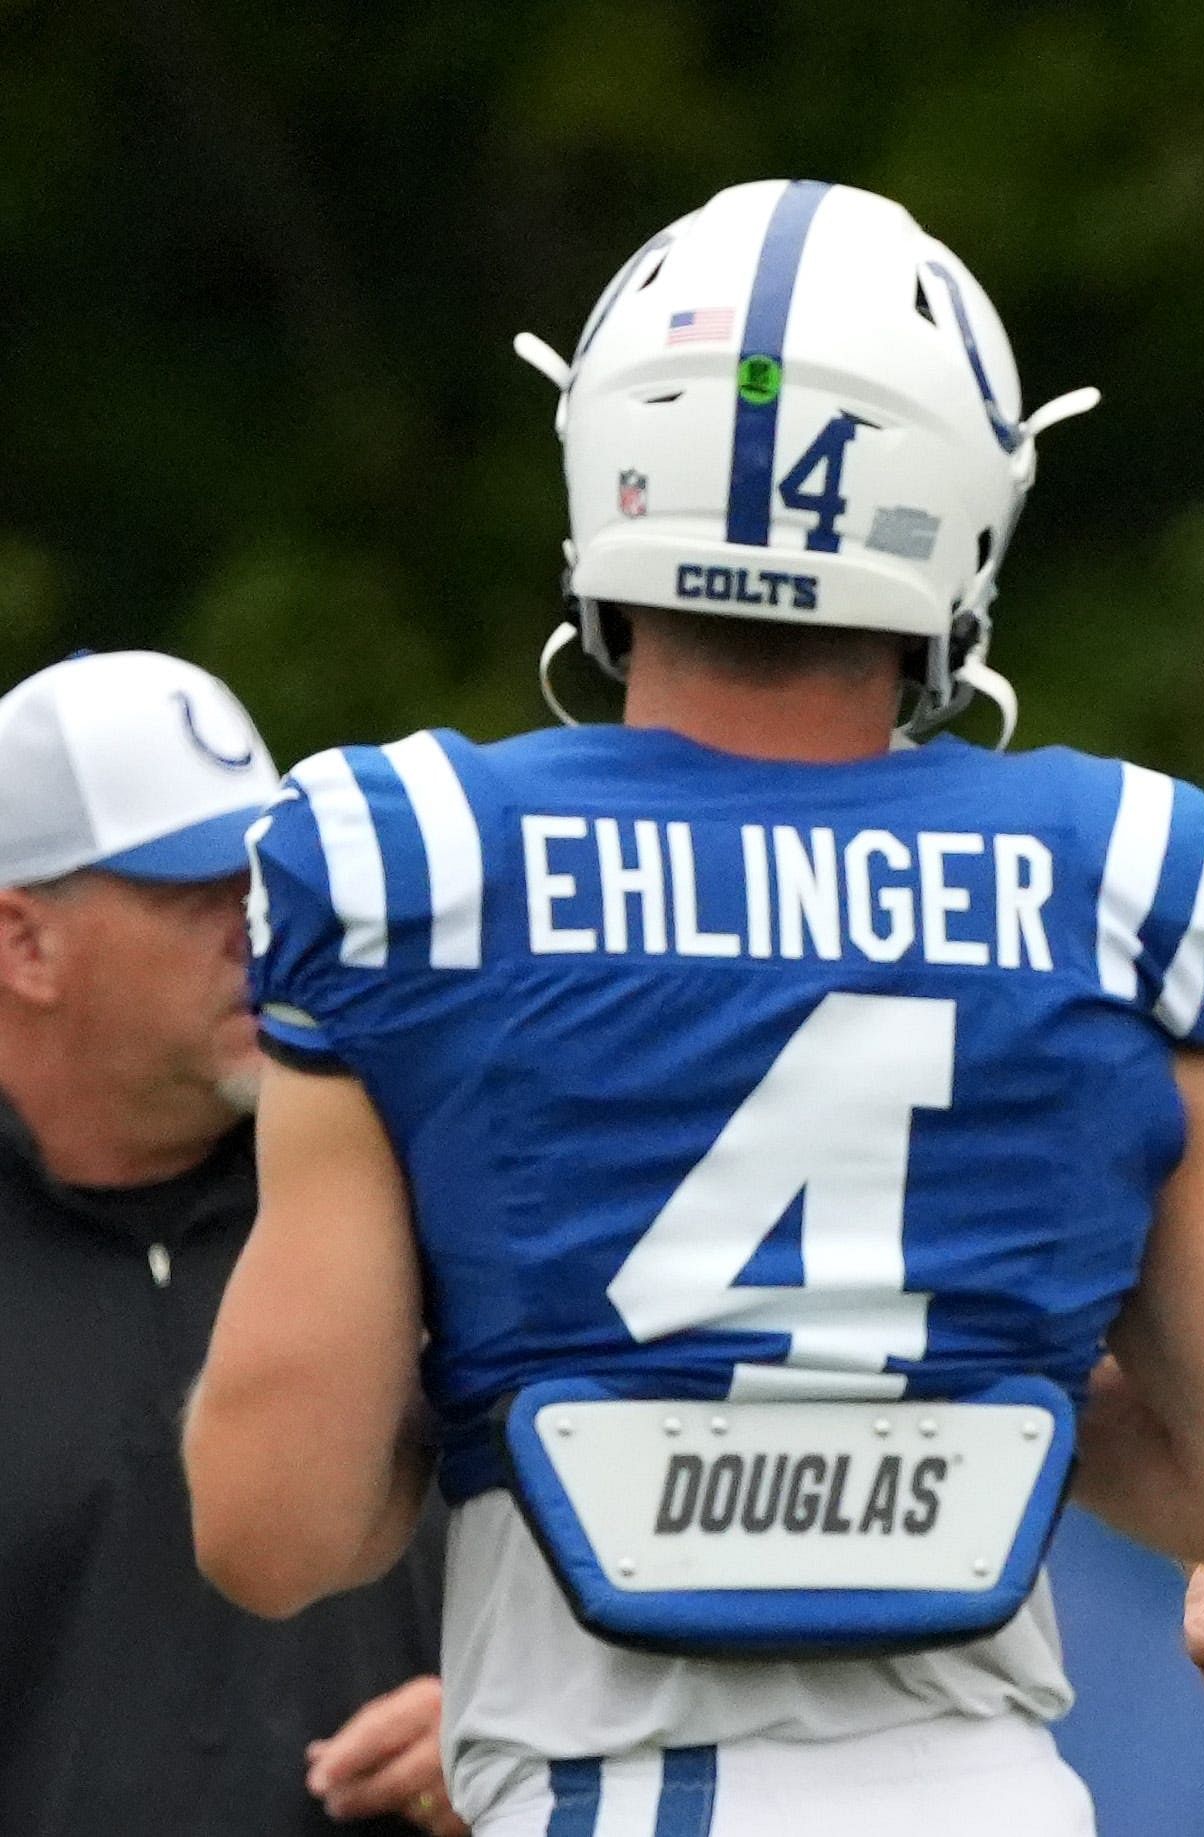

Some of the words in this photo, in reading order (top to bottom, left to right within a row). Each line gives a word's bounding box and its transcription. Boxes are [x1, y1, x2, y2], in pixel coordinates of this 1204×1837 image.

[778, 417, 856, 553] 4
[677, 563, 817, 609] COLTS
[521, 814, 1053, 973] EHLINGER
[606, 990, 957, 1400] 4
[653, 1453, 950, 1536] DOUGLAS
